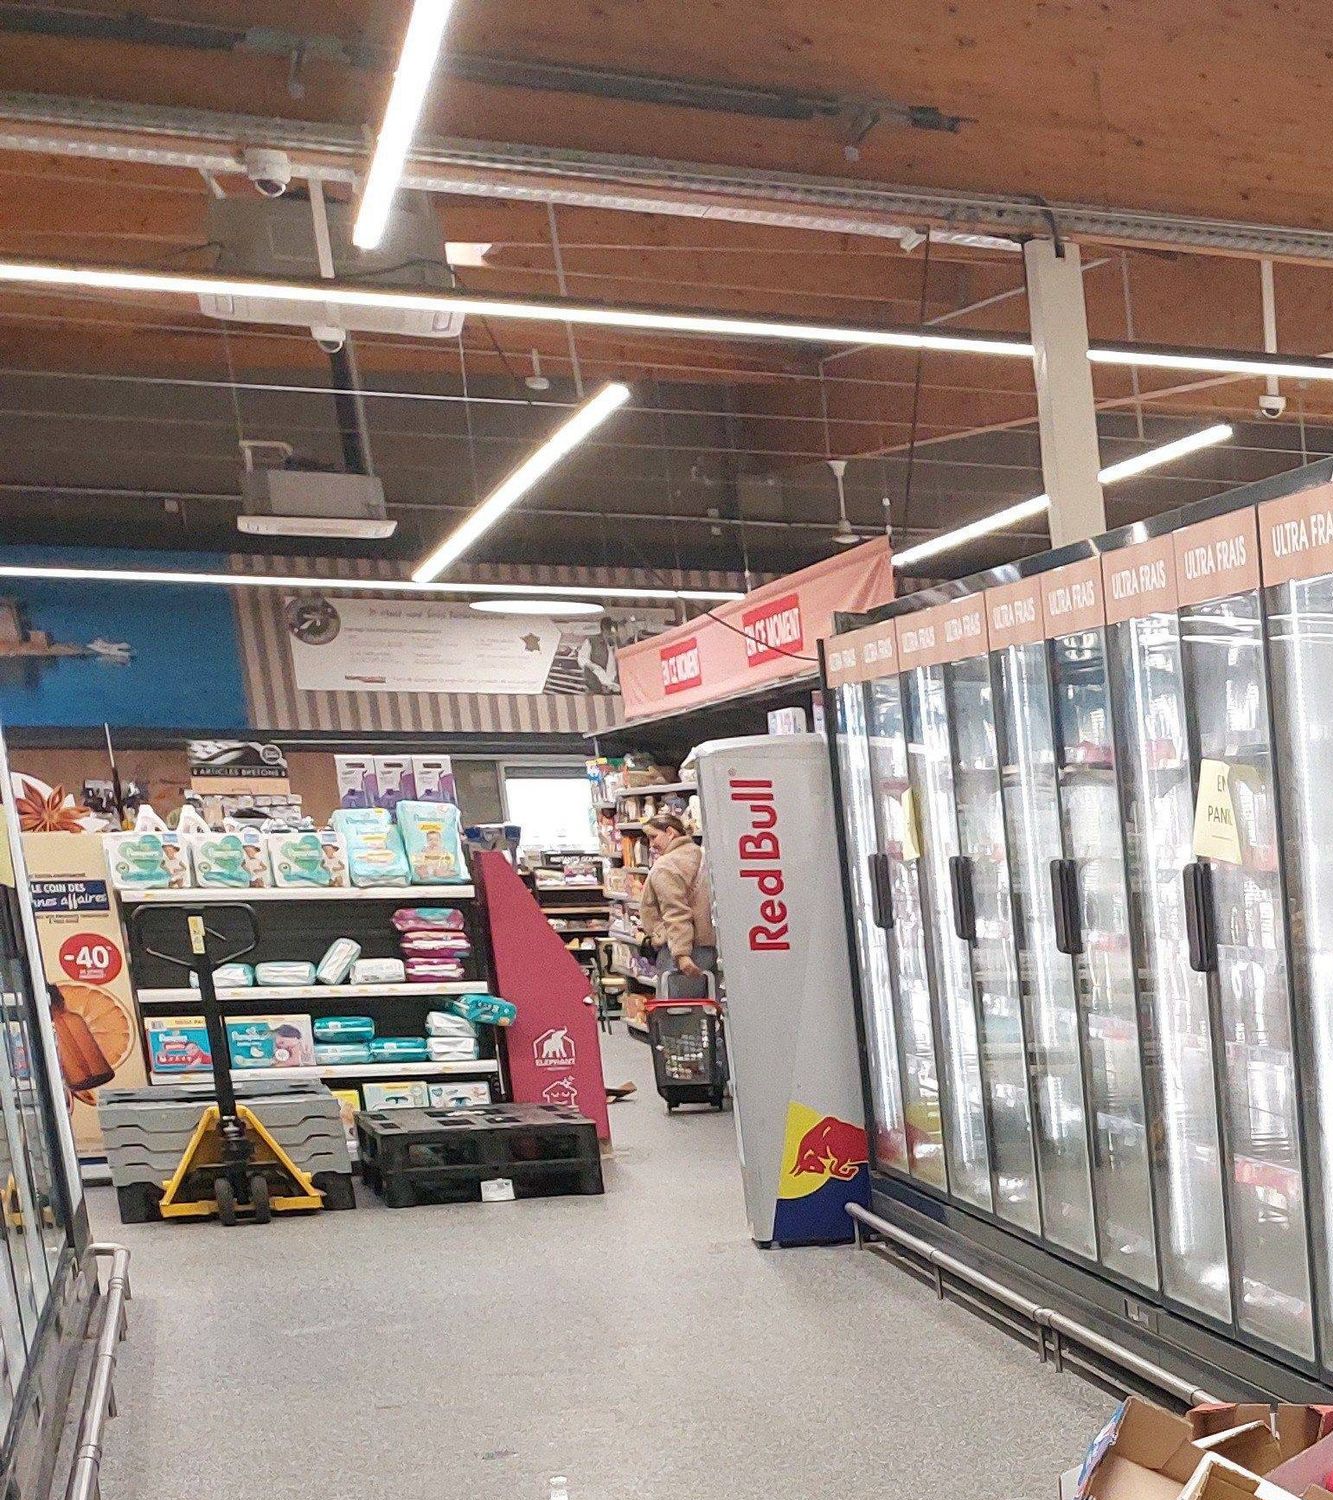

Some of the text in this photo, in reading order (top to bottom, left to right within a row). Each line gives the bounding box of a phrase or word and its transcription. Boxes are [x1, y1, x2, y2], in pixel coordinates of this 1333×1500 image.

[1184, 535, 1246, 580] ULTRA FRAIS
[1272, 523, 1308, 558] ULTRA
[1111, 560, 1167, 600] ULTRA FRAIS
[730, 780, 790, 950] Red Bull
[43, 883, 66, 893] COIN
[68, 882, 86, 892] DES
